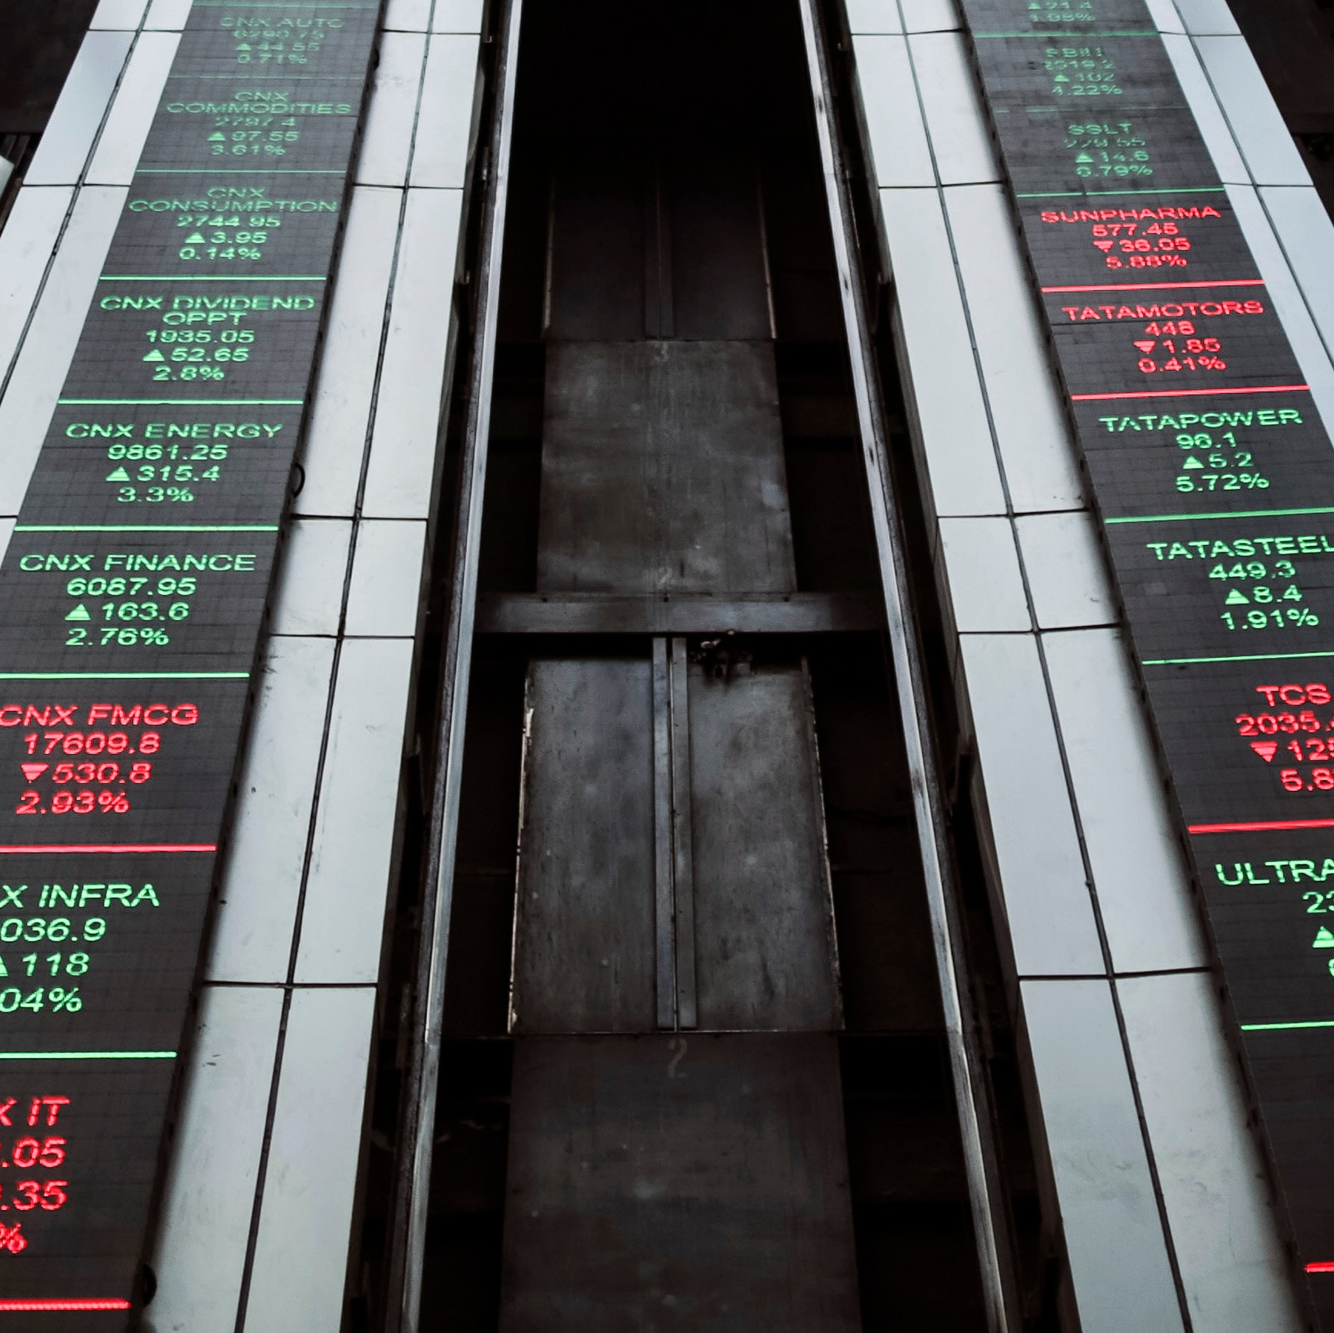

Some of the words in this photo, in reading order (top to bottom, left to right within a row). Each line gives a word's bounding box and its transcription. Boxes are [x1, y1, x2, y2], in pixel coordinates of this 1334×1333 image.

[220, 17, 270, 27] CNX
[235, 90, 288, 102] CNX
[167, 102, 349, 114] COMMODITIES
[231, 130, 298, 142] 97.55
[1068, 122, 1132, 135] SSLT
[212, 144, 285, 154] 3.61%
[207, 187, 264, 199] CNX
[129, 199, 337, 212] CONSUMPTION
[1041, 206, 1221, 222] SUNPHARMA
[211, 230, 267, 244] 3.95
[1092, 222, 1179, 237] 577.45
[179, 246, 261, 259] 0.14%
[1119, 237, 1191, 252] 36.05
[100, 296, 163, 310] CNX
[171, 296, 315, 312] DIVIDEND
[1061, 300, 1265, 320] TATAMOTORS
[163, 311, 248, 325] OPPT
[1145, 320, 1195, 335] 448
[147, 330, 255, 343] 1935.05
[1163, 338, 1221, 353] 1.85
[170, 347, 249, 362] 52.65
[153, 365, 225, 380] 2.8%
[1138, 356, 1227, 373] 0.41%
[1098, 408, 1303, 432] TATAPOWER
[66, 423, 134, 438] CNX
[144, 423, 282, 438] ENERGY
[1176, 432, 1236, 449] 96.1
[108, 443, 227, 460] 9861.25
[1208, 452, 1253, 468] 5.2
[137, 464, 220, 481] 315.4
[1176, 473, 1270, 492] 5.72%
[118, 486, 194, 502] 3.3%
[19, 554, 94, 570] CNX
[104, 554, 254, 571] FINANCE
[1209, 560, 1296, 580] 449.3
[66, 577, 197, 595] 6087.95
[1253, 585, 1303, 603] 8.4
[102, 601, 189, 620] 163.6
[1221, 608, 1320, 630] 1.91%
[66, 627, 170, 646] 2.76%
[1256, 683, 1331, 706] TCS
[87, 703, 199, 725] FMCG
[25, 731, 161, 754] 17609.8
[52, 762, 152, 784] 530.8
[15, 790, 130, 814] 2.93%
[39, 883, 160, 908] INFRA
[23, 951, 90, 976] 118
[27, 1096, 71, 1126] IT
